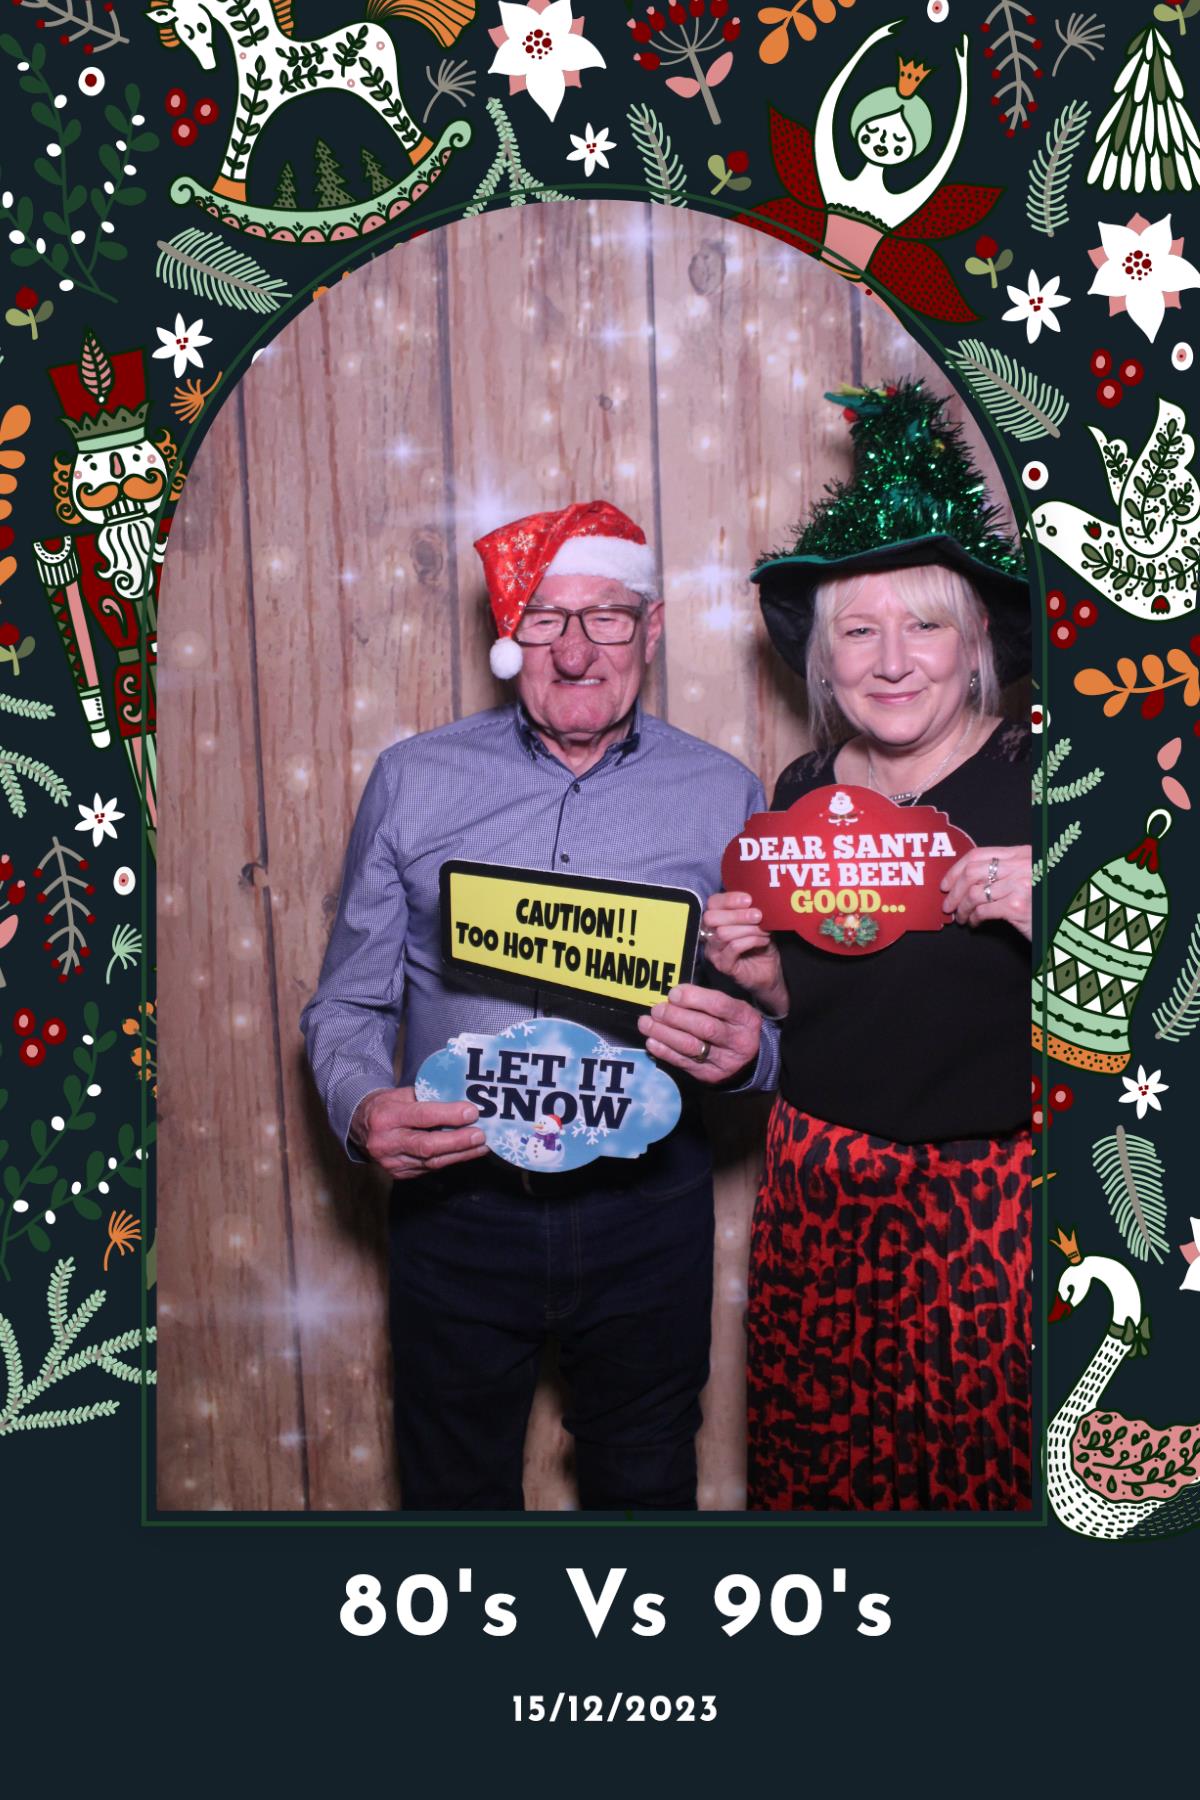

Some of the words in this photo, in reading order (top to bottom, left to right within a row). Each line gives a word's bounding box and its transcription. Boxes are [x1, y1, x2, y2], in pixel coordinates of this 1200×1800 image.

[739, 836, 826, 861] DEAR
[833, 832, 956, 860] SANTA
[768, 863, 831, 887] I'VE
[837, 861, 925, 886] BEEN
[790, 889, 905, 913] GOOD...
[456, 922, 498, 951] TOO
[503, 932, 548, 963] HOT
[552, 940, 581, 971] TO
[586, 949, 675, 996] HANDLE
[466, 1047, 566, 1088] LET
[579, 1058, 634, 1093] IT
[465, 1084, 632, 1129] SNOW
